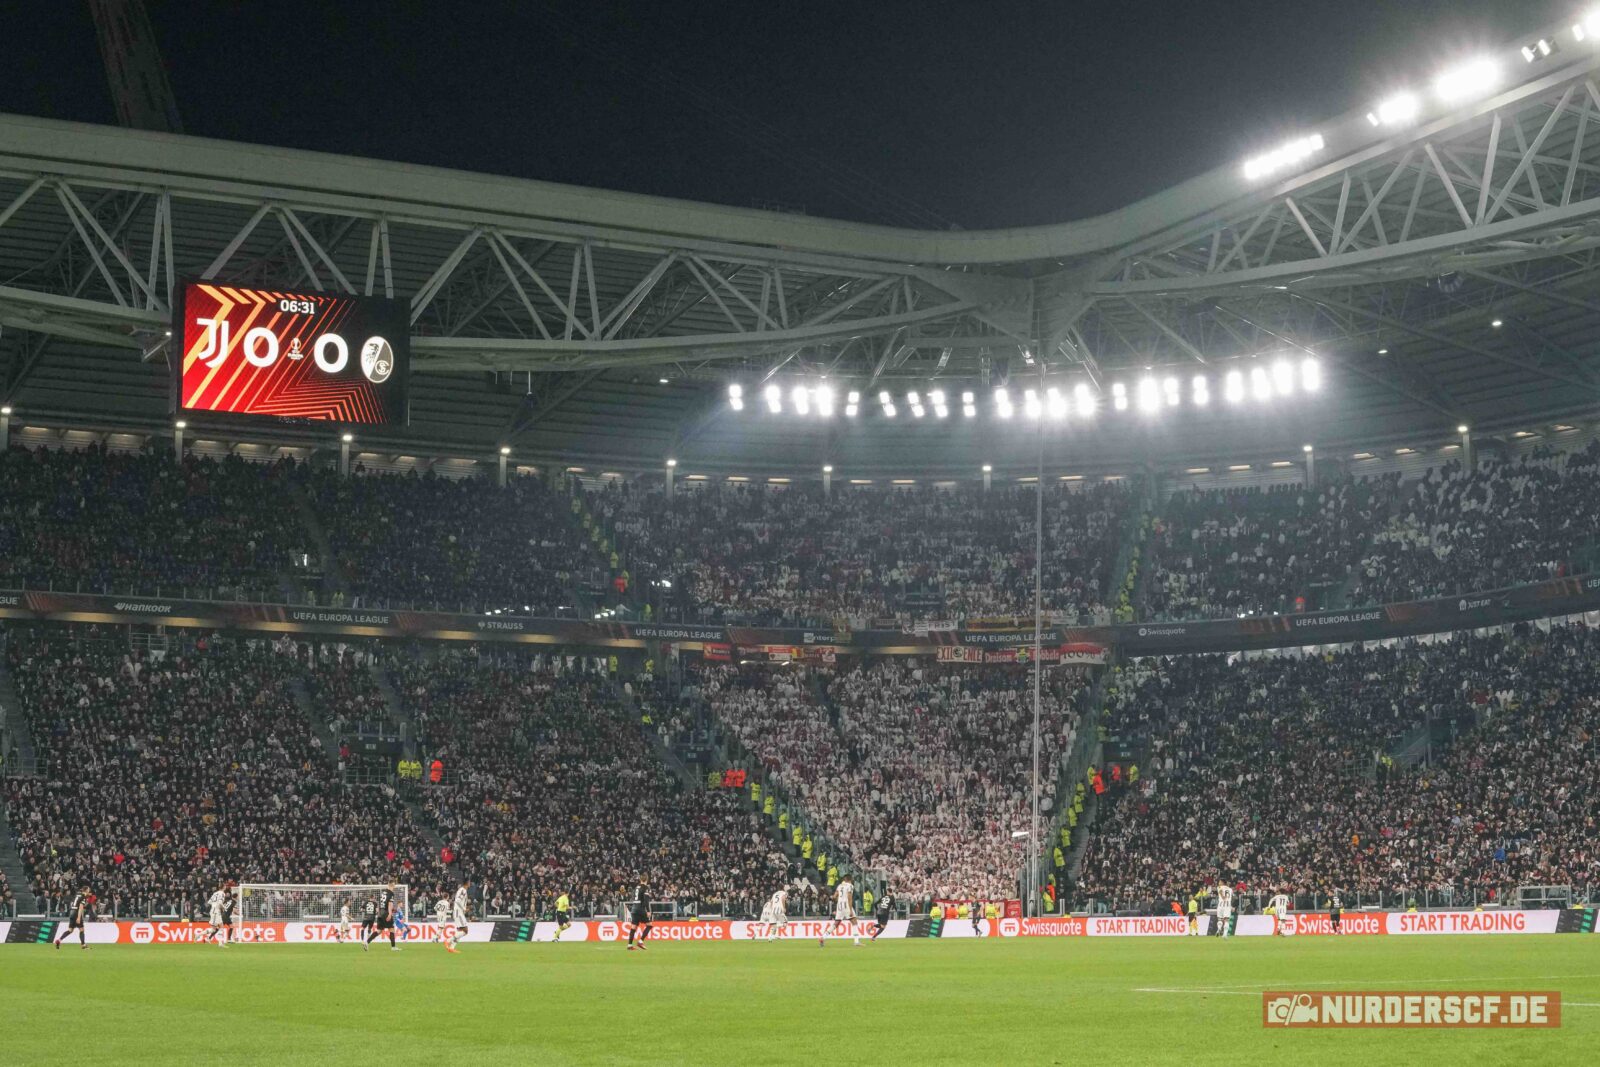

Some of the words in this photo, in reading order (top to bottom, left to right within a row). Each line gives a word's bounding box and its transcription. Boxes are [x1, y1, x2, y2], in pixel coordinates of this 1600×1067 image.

[280, 300, 315, 314] 06:31
[243, 327, 279, 367] 0
[314, 332, 349, 373] 0
[293, 612, 316, 620] UEFA
[319, 613, 353, 622] EUROPA
[355, 615, 389, 624] LEAGUE
[487, 622, 524, 630] STRAUSS
[1296, 618, 1317, 627] UEFA
[1319, 615, 1349, 625] EUROPA
[1351, 611, 1380, 622] LEAGUE
[636, 629, 657, 637] UEFA
[658, 630, 689, 638] EUROPA
[690, 631, 721, 640] LEAGUE
[965, 634, 987, 642] UEFA
[989, 634, 1021, 642] EUROPA
[1023, 633, 1057, 641] LEAGUE
[1022, 918, 1082, 936] Swissquote
[1096, 919, 1131, 933] START
[1132, 918, 1186, 933] TRADING
[1400, 915, 1447, 931] START
[1449, 913, 1525, 930] TRADING
[303, 924, 363, 941] STAT
[621, 921, 723, 941] Swissquote
